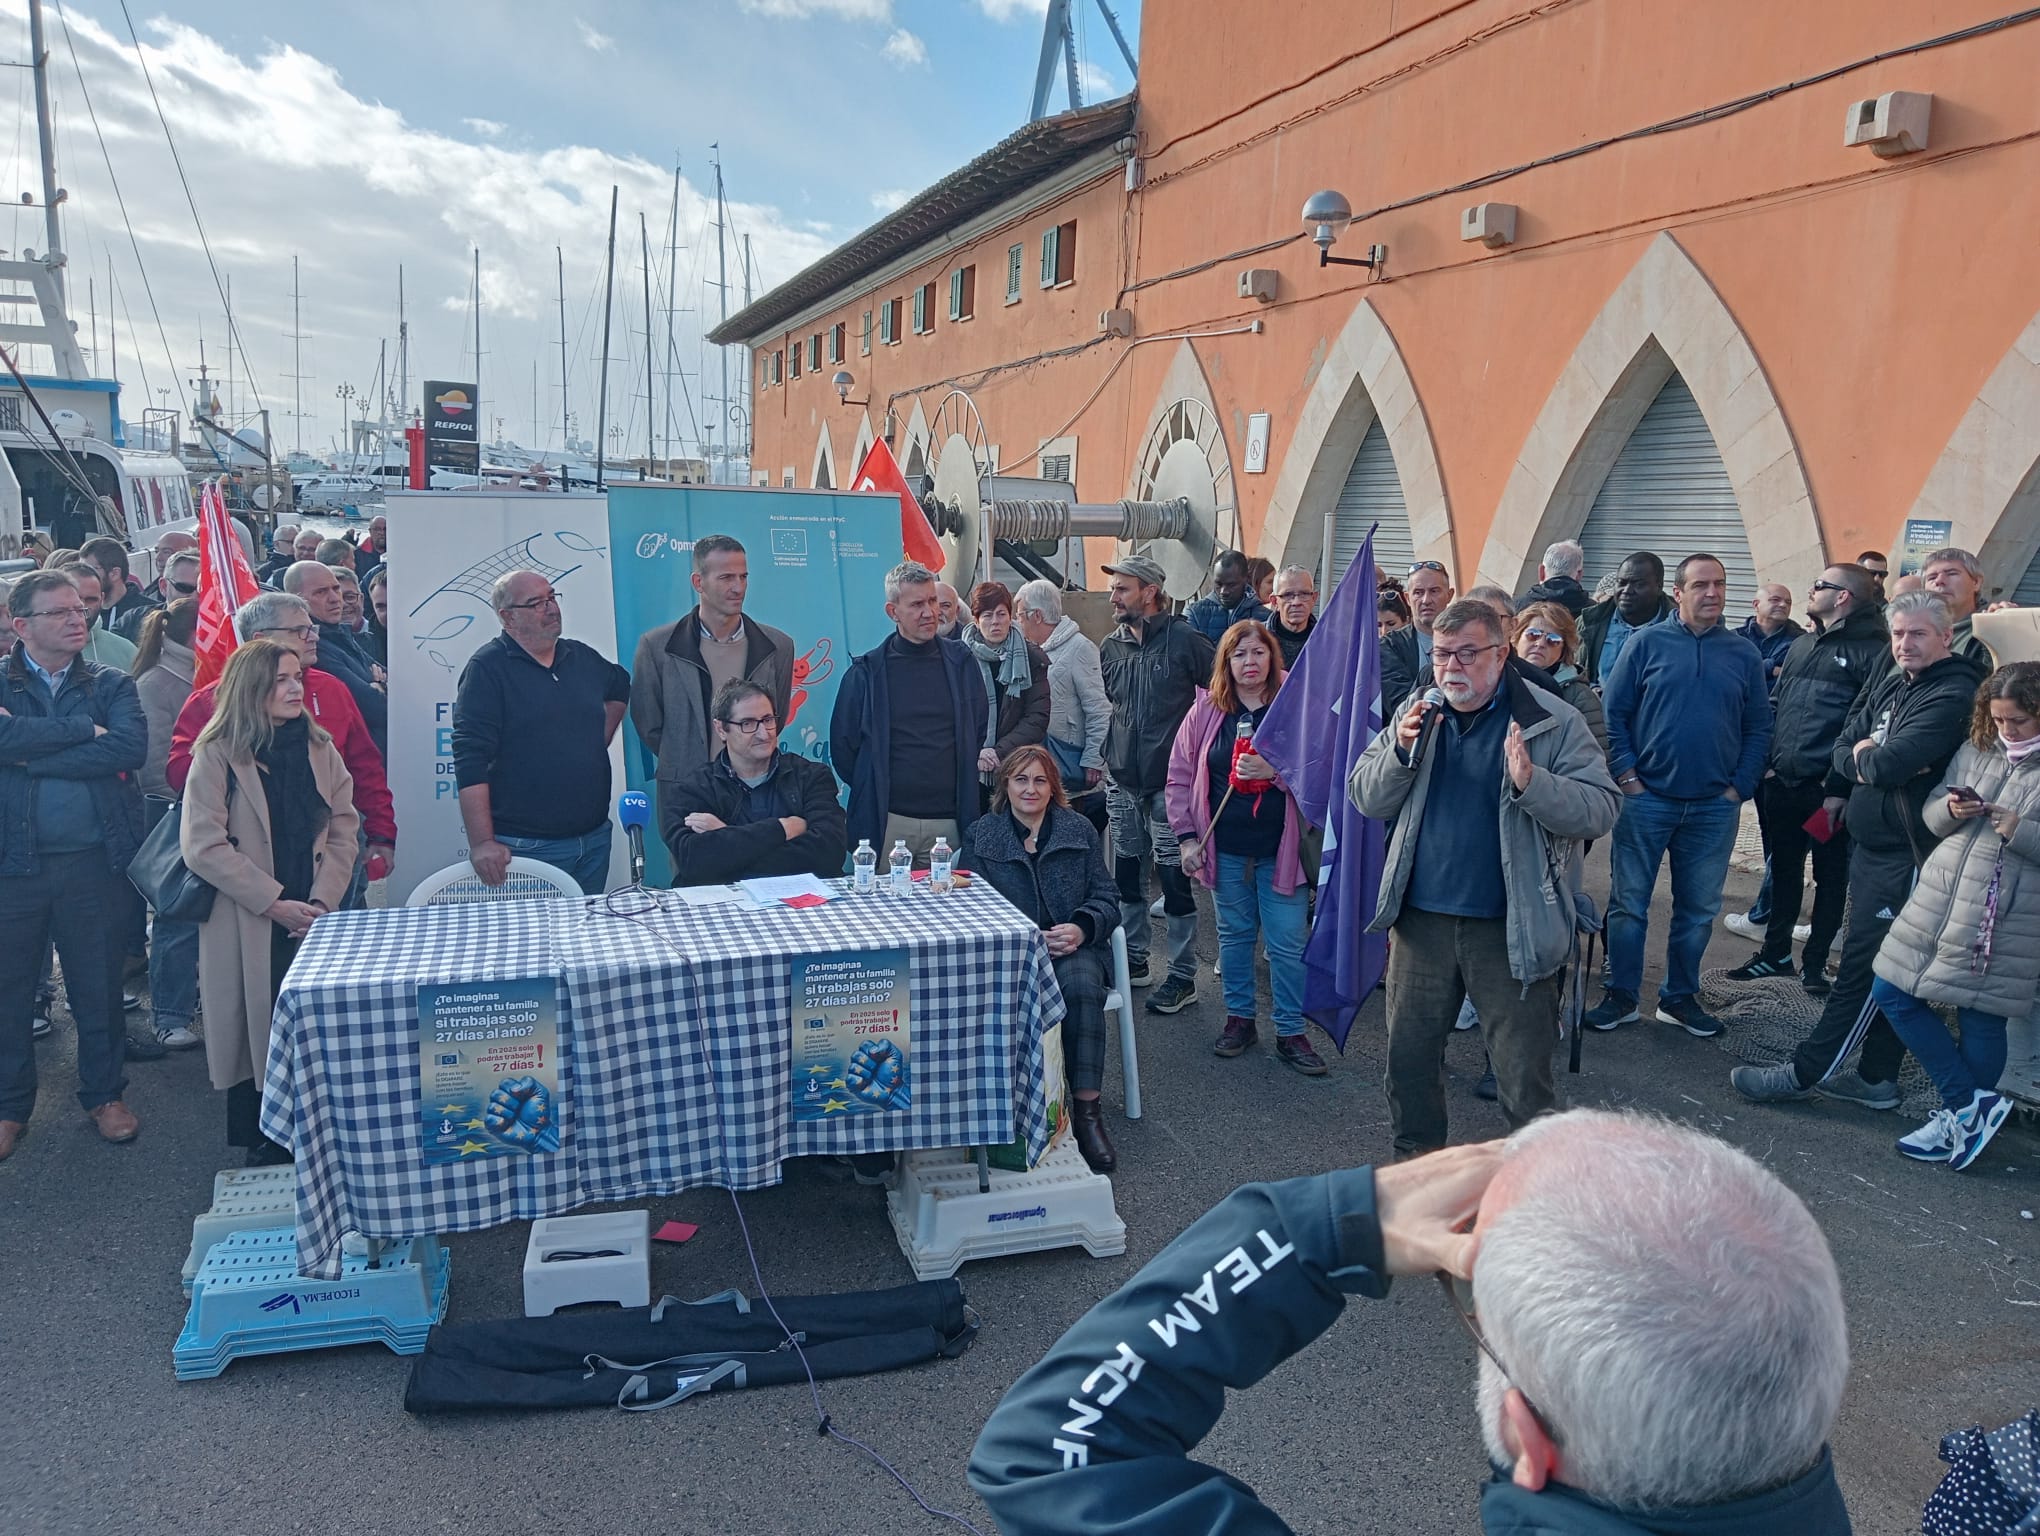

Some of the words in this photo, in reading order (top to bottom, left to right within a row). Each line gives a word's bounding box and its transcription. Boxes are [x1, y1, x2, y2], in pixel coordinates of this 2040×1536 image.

[434, 421, 474, 431] REPSOL
[624, 798, 647, 808] tve
[805, 964, 821, 974] ¿Te
[822, 962, 862, 972] imaginas
[805, 973, 848, 984] mantener
[856, 971, 866, 979] tu
[866, 968, 896, 979] familia
[805, 985, 816, 996] si
[817, 982, 868, 995] trabajas
[869, 979, 894, 990] solo
[435, 995, 452, 1005] ¿Te
[453, 993, 499, 1004] imaginas
[805, 998, 821, 1008] 27
[822, 995, 847, 1007] días
[849, 995, 860, 1005] al
[862, 992, 890, 1004] año?
[435, 1005, 485, 1015] mantener
[494, 1003, 504, 1011] tu
[505, 1000, 539, 1011] familia
[436, 1018, 448, 1029] si
[450, 1014, 507, 1028] trabajas
[509, 1011, 537, 1023] solo
[436, 1032, 454, 1043] 27
[455, 1029, 484, 1042] días
[486, 1029, 499, 1040] al
[502, 1025, 533, 1038] año?
[855, 1026, 868, 1034] 27
[869, 1023, 890, 1033] días
[493, 1063, 508, 1072] 27
[510, 1060, 534, 1070] días
[1148, 1229, 1294, 1348] TEAM
